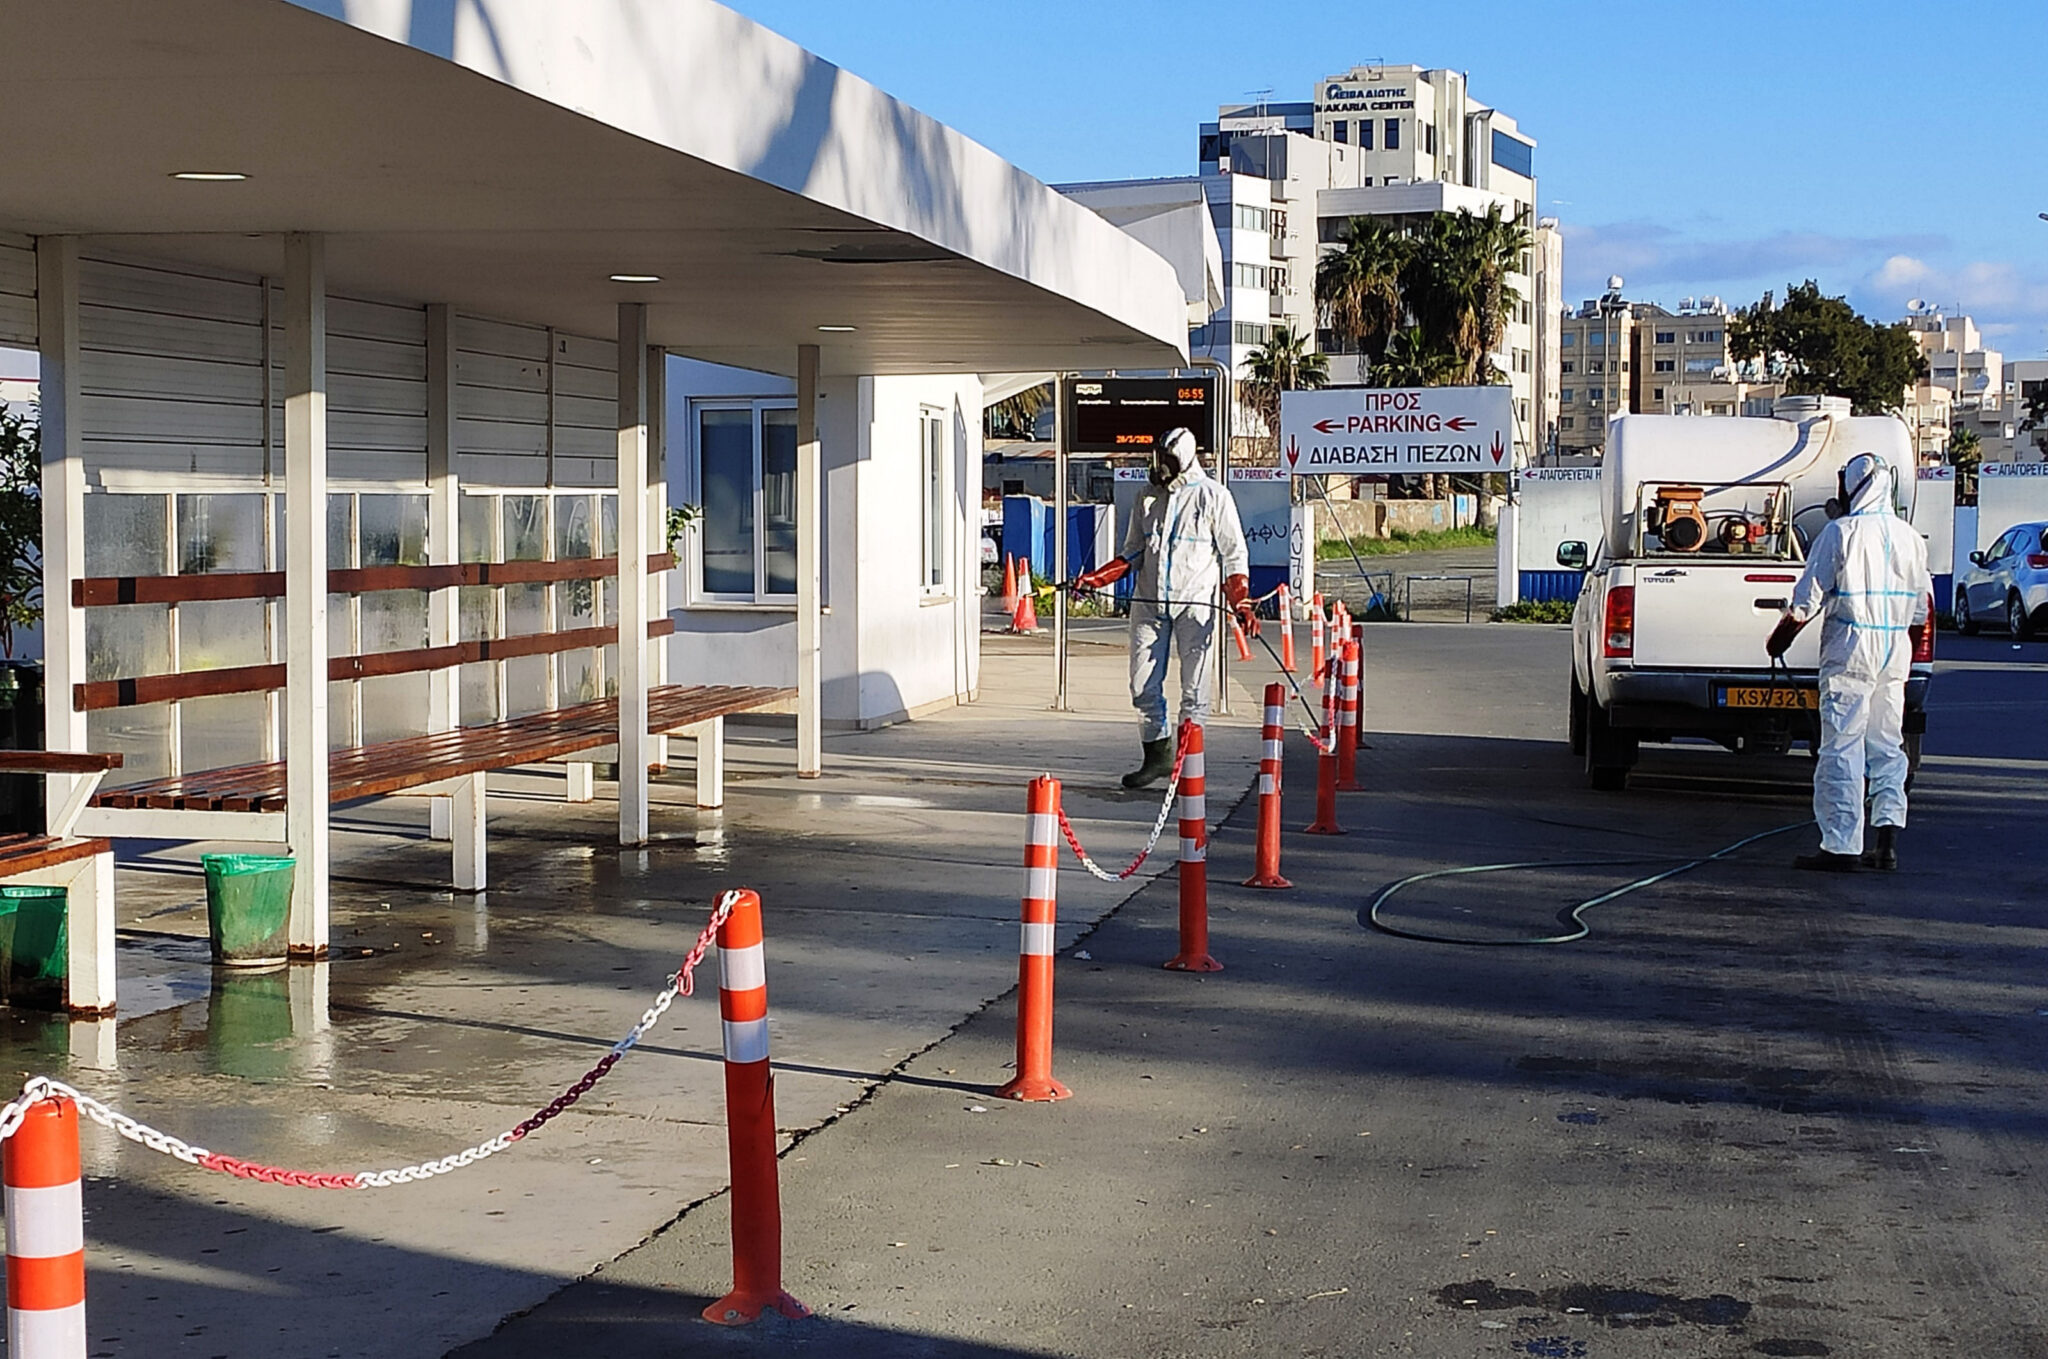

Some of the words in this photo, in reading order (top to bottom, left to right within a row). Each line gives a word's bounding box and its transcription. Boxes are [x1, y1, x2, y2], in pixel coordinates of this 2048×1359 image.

[1315, 103, 1368, 112] MAKARIA
[1371, 101, 1414, 110] CENTER
[1365, 393, 1421, 411] ΠΡΟΣ
[1348, 415, 1441, 433] PARKING
[1310, 446, 1397, 464] ΔΙΑΒΑΣΗ
[1407, 445, 1480, 462] ΠΕΖΩΝ
[1233, 469, 1243, 479] NO
[1245, 469, 1273, 479] PARKING
